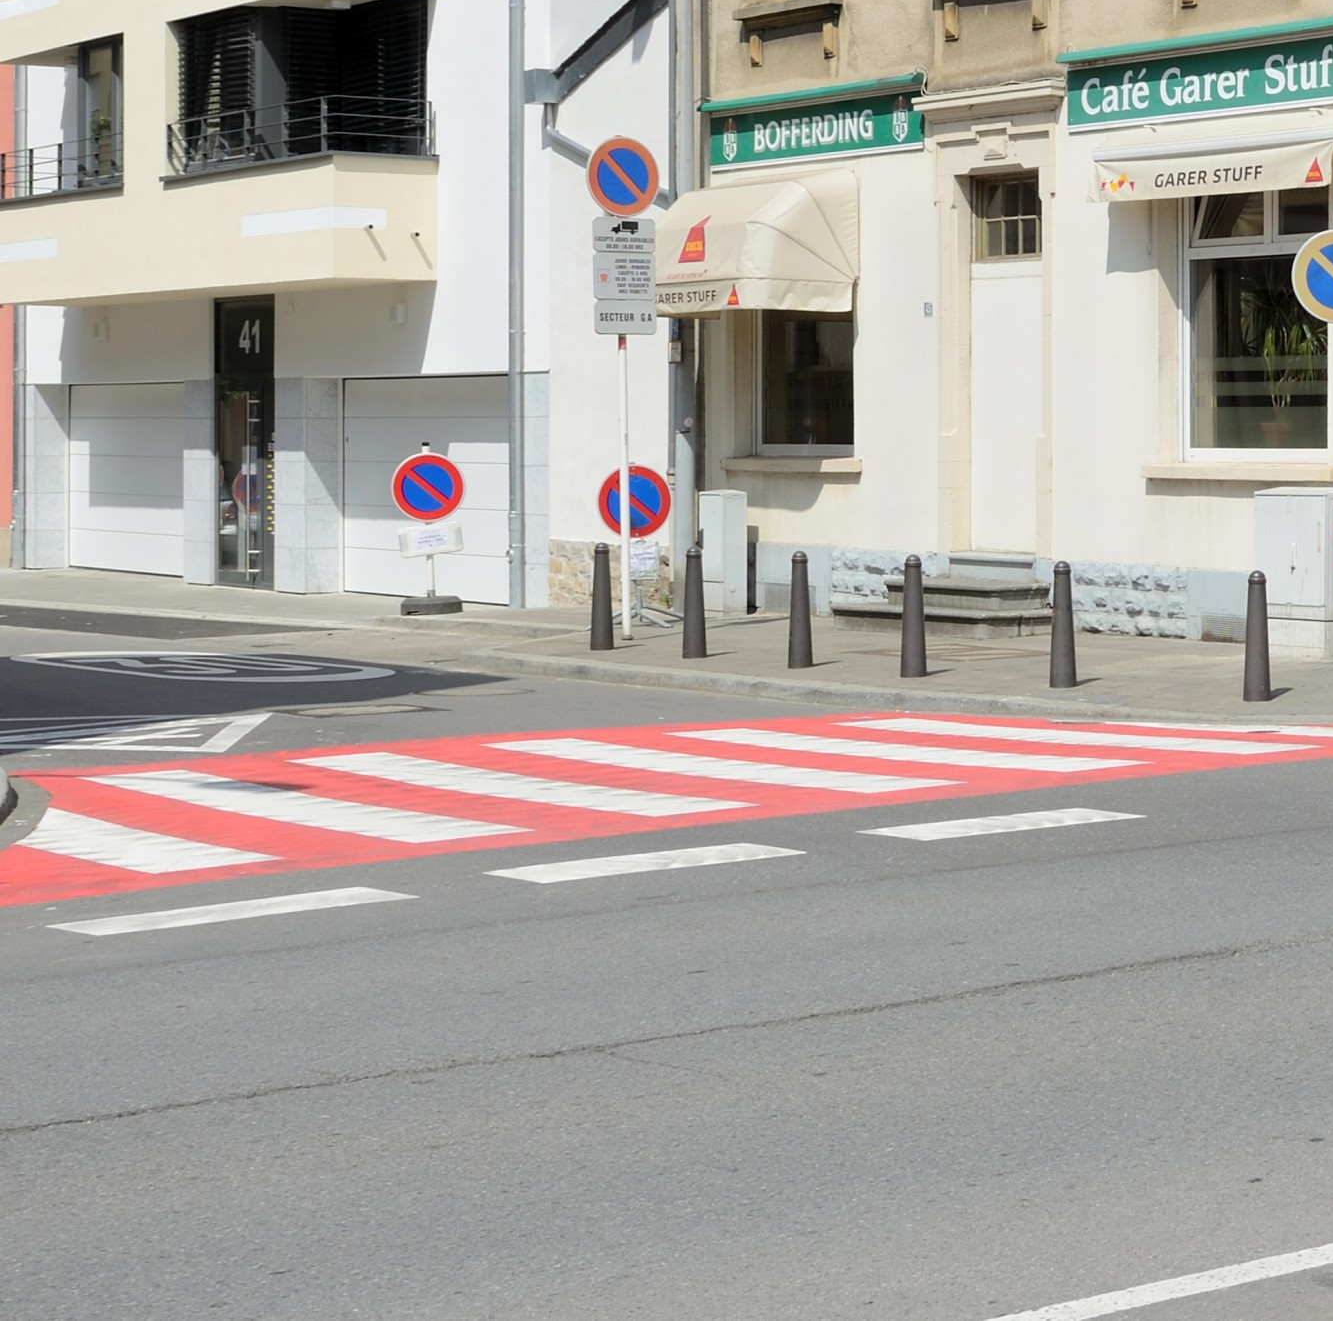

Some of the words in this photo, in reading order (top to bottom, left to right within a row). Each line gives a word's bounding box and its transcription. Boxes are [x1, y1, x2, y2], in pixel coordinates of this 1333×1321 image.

[1081, 68, 1149, 116] Café
[1160, 67, 1250, 107] Garer
[753, 109, 874, 153] BOFFERDING
[1154, 169, 1208, 189] GARER
[1213, 165, 1263, 185] STUFF
[655, 293, 684, 305] ARER
[687, 290, 716, 303] STUFF
[599, 312, 634, 322] SECTEUR
[239, 319, 260, 354] 41
